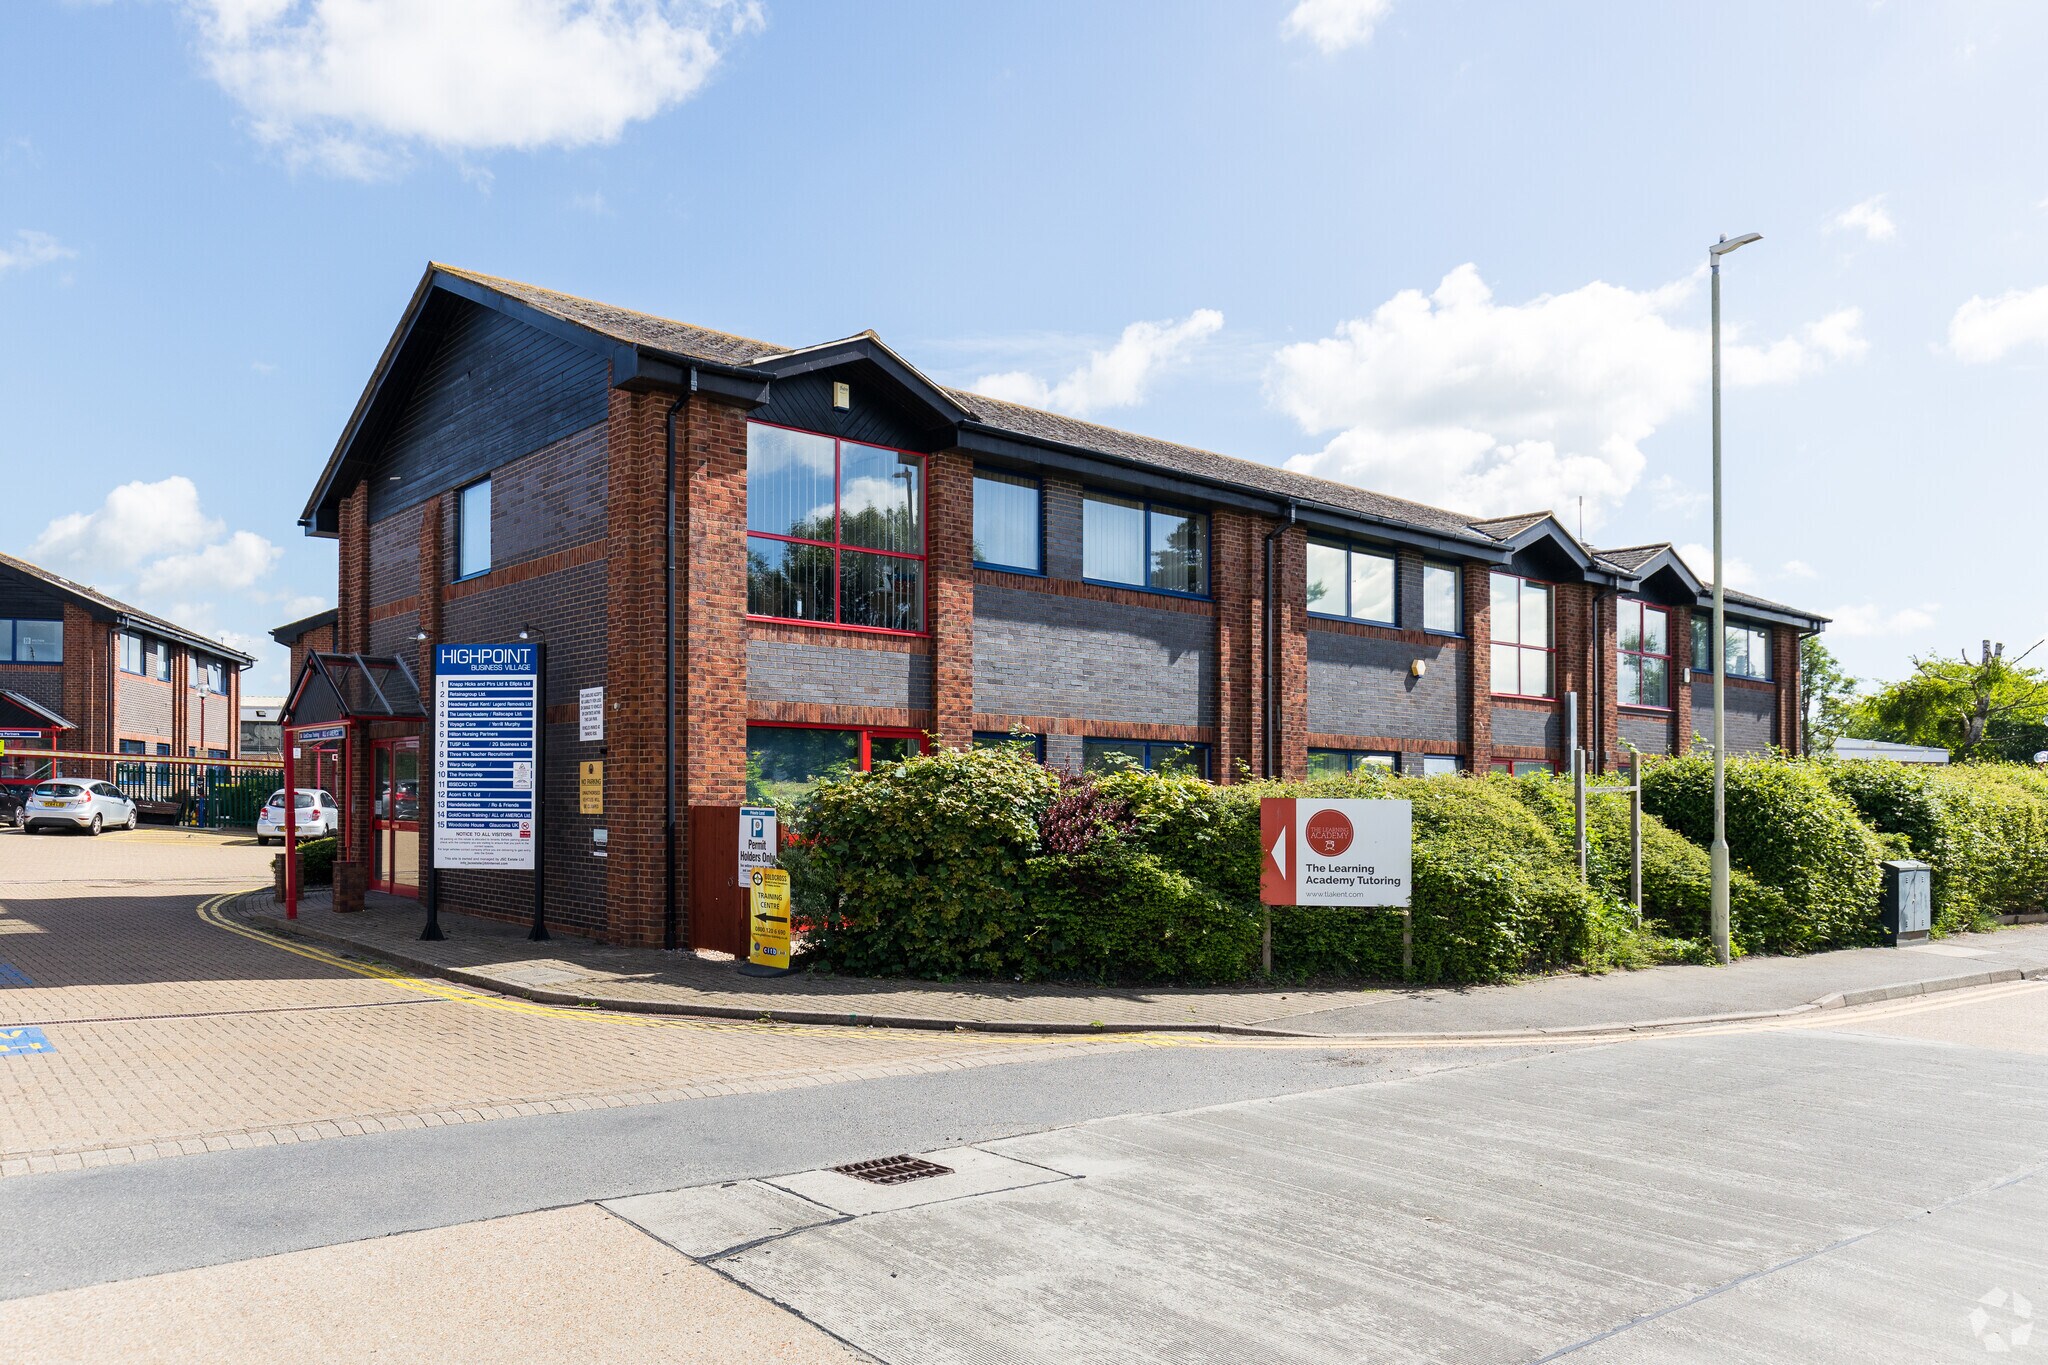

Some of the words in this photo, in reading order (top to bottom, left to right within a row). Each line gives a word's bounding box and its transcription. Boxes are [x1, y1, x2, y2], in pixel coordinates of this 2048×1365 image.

[442, 649, 530, 664] HIGHPOINT
[748, 839, 766, 850] Permit
[741, 851, 761, 861] Holders
[762, 852, 775, 863] Only
[1306, 864, 1326, 872] The
[1328, 864, 1374, 875] Learning
[1306, 876, 1355, 886] Academy
[1357, 876, 1400, 887] Tutoring
[758, 892, 782, 901] TRAINING
